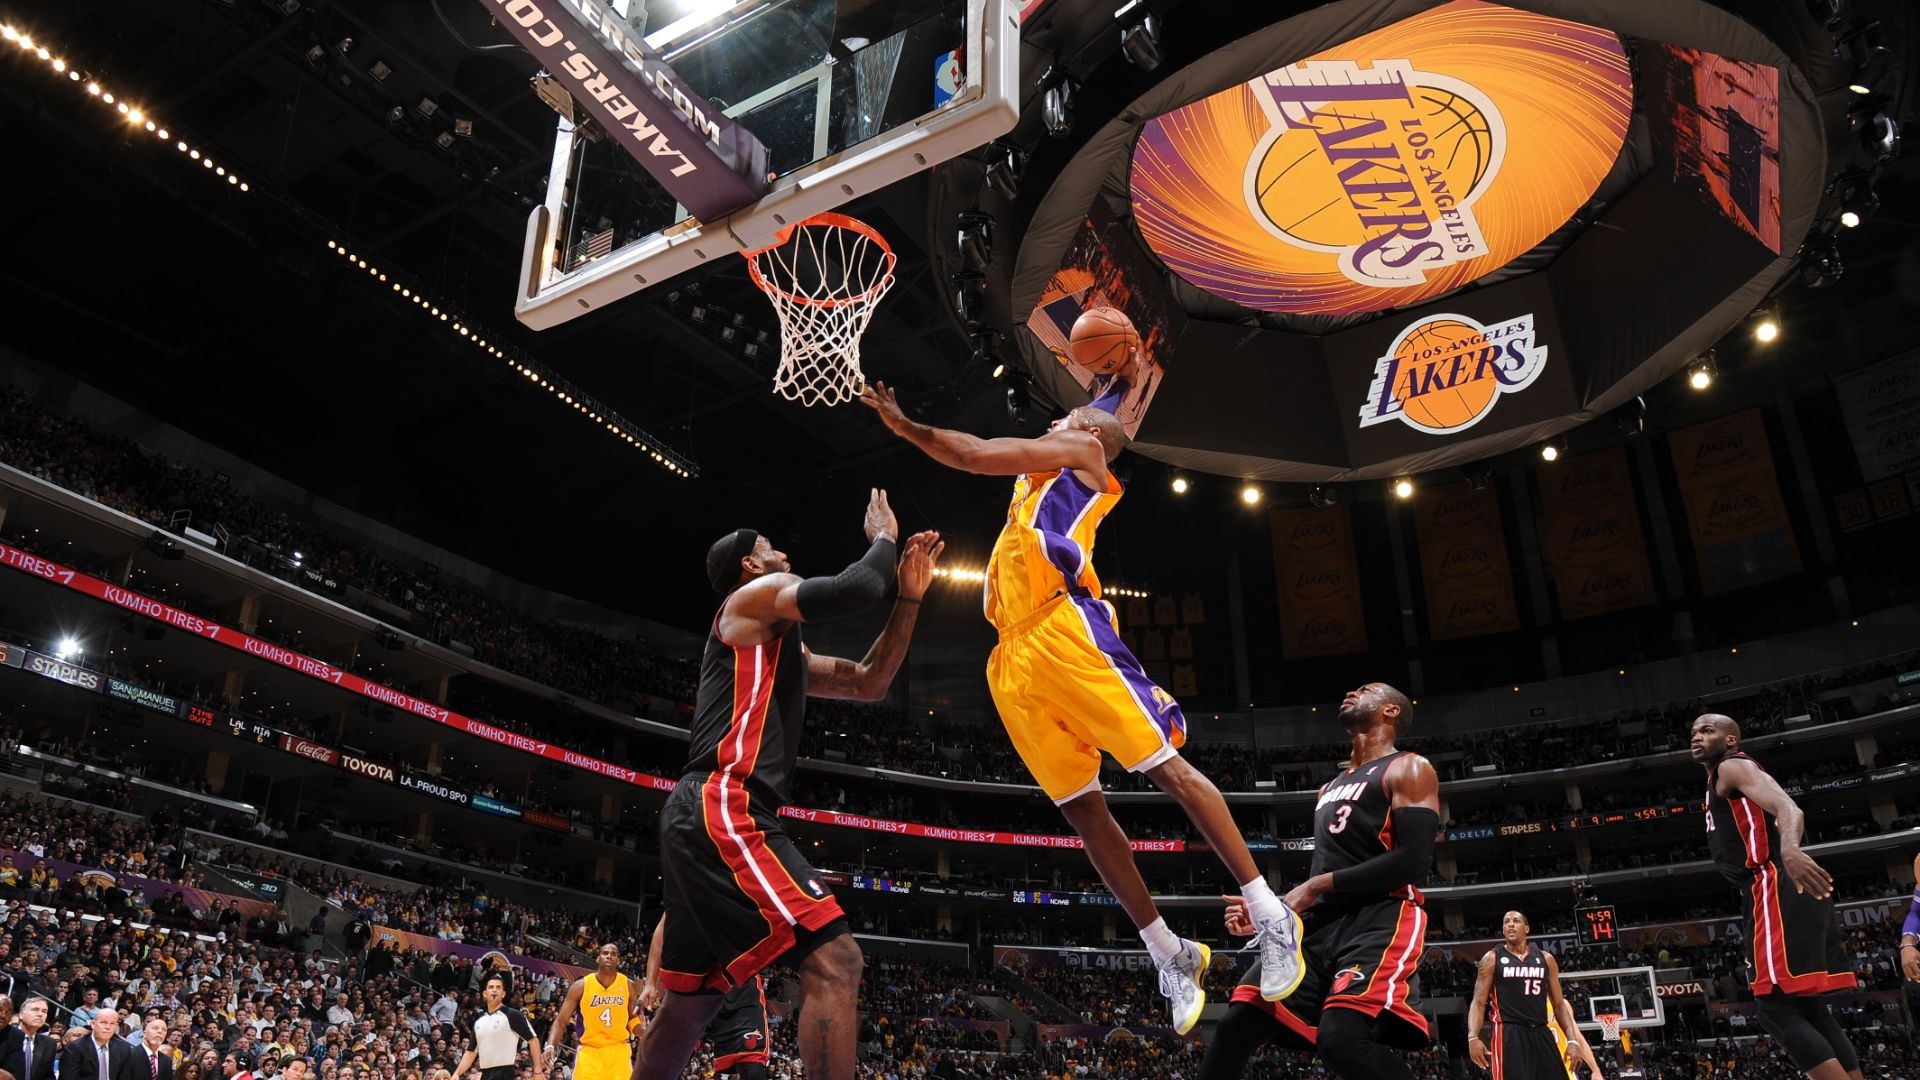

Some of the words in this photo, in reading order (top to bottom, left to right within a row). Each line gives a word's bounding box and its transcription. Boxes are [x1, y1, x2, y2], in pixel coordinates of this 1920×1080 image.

[495, 0, 698, 178] LAKERS.CO
[1262, 70, 1446, 280] LAKERS
[1400, 118, 1436, 160] LOS
[1420, 166, 1476, 254] ANGELES
[1412, 345, 1442, 362] LOS
[1445, 321, 1527, 353] ANGELES
[1368, 337, 1539, 421] LAKERS
[9, 550, 55, 578] TIRES
[104, 586, 162, 617] KUMHO
[165, 608, 204, 633] TIRES
[244, 637, 294, 668] KUMHO
[295, 655, 330, 680] TIRES
[32, 656, 98, 689] STAPLES
[111, 681, 132, 695] SAN
[138, 688, 176, 709] MANUEL
[364, 682, 406, 707] KUMHO
[408, 699, 437, 719] TIRES
[191, 706, 214, 720] TIME
[229, 718, 246, 730] LAL
[253, 725, 270, 738] MIA
[467, 721, 506, 743] KUMHO
[507, 734, 535, 752] TIRES
[257, 734, 263, 743] 6
[342, 755, 394, 782] TOYOTA
[564, 752, 600, 772] KUMHO
[601, 763, 626, 780] TIRES
[1871, 769, 1906, 781] Panasonic
[653, 778, 676, 792] KUM
[449, 790, 467, 803] SPO
[781, 806, 806, 819] TIRES
[1329, 805, 1352, 834] 3
[834, 814, 870, 828] KUMHO
[871, 820, 897, 832] TIRES
[1500, 823, 1541, 836] STAPLES
[924, 826, 957, 840] KUMHO
[959, 831, 985, 842] TIRES
[1013, 835, 1049, 846] KUMHO
[1050, 837, 1075, 848] TIRES
[1460, 830, 1494, 840] DELTA
[1138, 841, 1165, 851] TIRES
[260, 883, 278, 893] 3D
[1090, 896, 1119, 905] DELTA
[1587, 911, 1611, 921] 4:59
[1593, 922, 1612, 940] 14
[1503, 966, 1545, 979] MIAMI
[1524, 979, 1541, 996] 15
[591, 994, 624, 1007] LAKERS
[599, 1008, 611, 1027] 4
